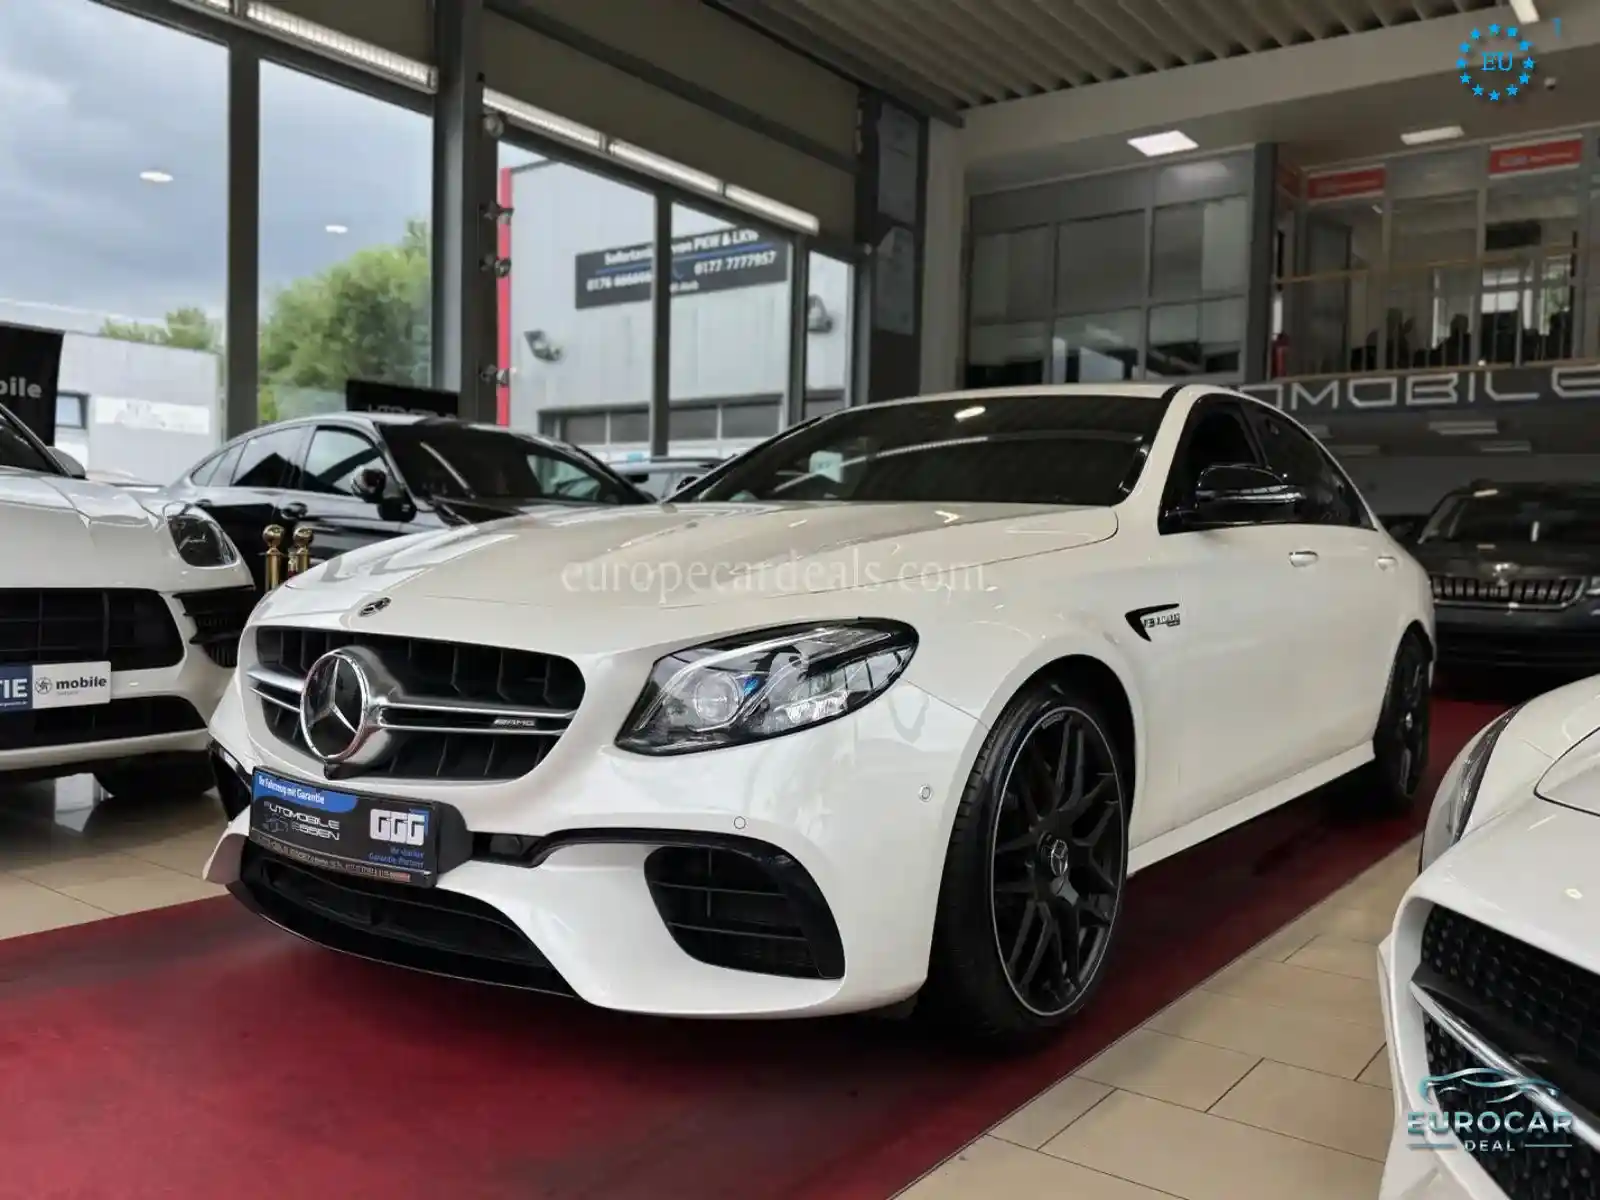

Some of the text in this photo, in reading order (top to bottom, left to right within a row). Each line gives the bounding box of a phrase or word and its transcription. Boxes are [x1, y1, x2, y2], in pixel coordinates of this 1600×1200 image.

[56, 676, 107, 690] mobile
[297, 789, 325, 805] Garantie
[263, 800, 341, 830] AUTOMOBILE
[291, 820, 341, 841] ESSEN
[370, 808, 425, 846] GGG
